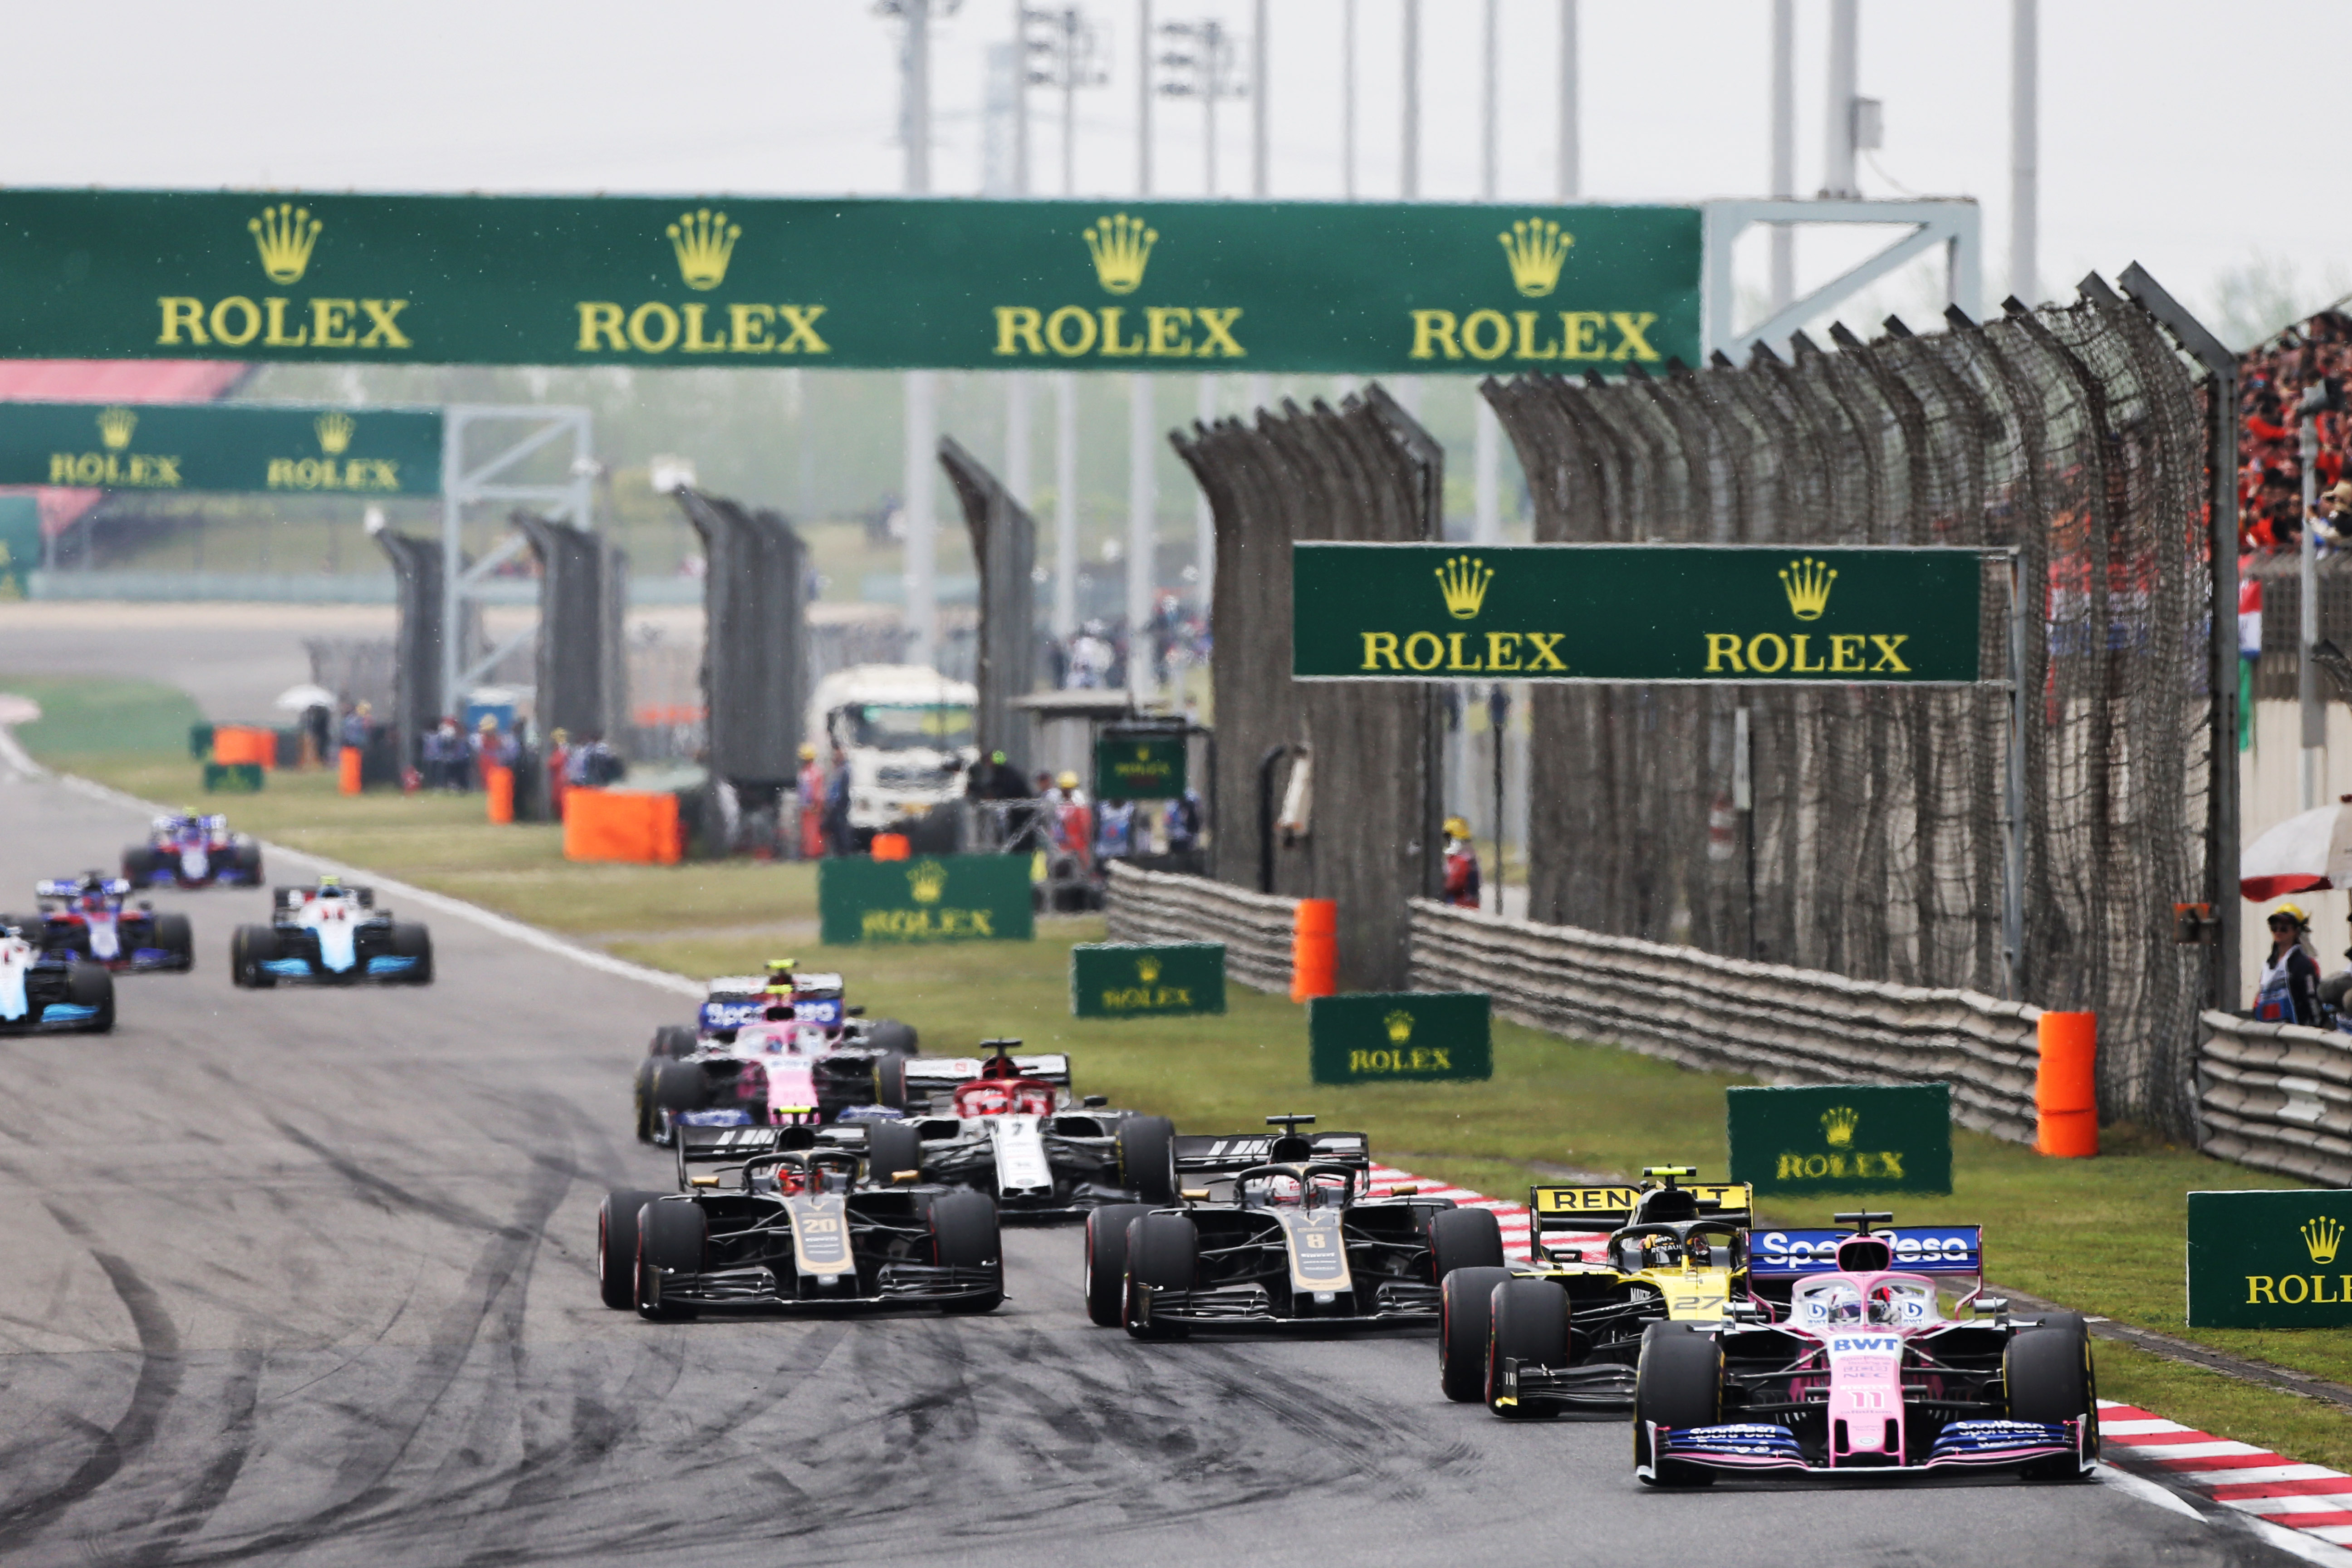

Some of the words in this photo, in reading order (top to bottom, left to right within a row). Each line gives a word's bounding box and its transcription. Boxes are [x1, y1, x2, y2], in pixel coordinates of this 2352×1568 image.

[157, 296, 412, 348] ROLEX
[576, 301, 831, 354] ROLEX
[994, 305, 1247, 357] ROLEX
[1409, 309, 1661, 361] ROLEX
[49, 453, 181, 487] ROLEX
[267, 458, 399, 490] ROLEX
[1361, 631, 1568, 671] ROLEX
[1704, 633, 1911, 672] ROLEX
[1349, 1048, 1451, 1072] ROLEX
[1776, 1151, 1905, 1180] ROLEX
[802, 1218, 838, 1233] 20
[1307, 1234, 1326, 1249] 8
[1651, 1245, 1683, 1253] RENAUL
[1763, 1230, 1968, 1269] SpoPesa
[1674, 1296, 1726, 1310] 27
[1834, 1338, 1898, 1352] BWT
[1847, 1391, 1885, 1409] 11
